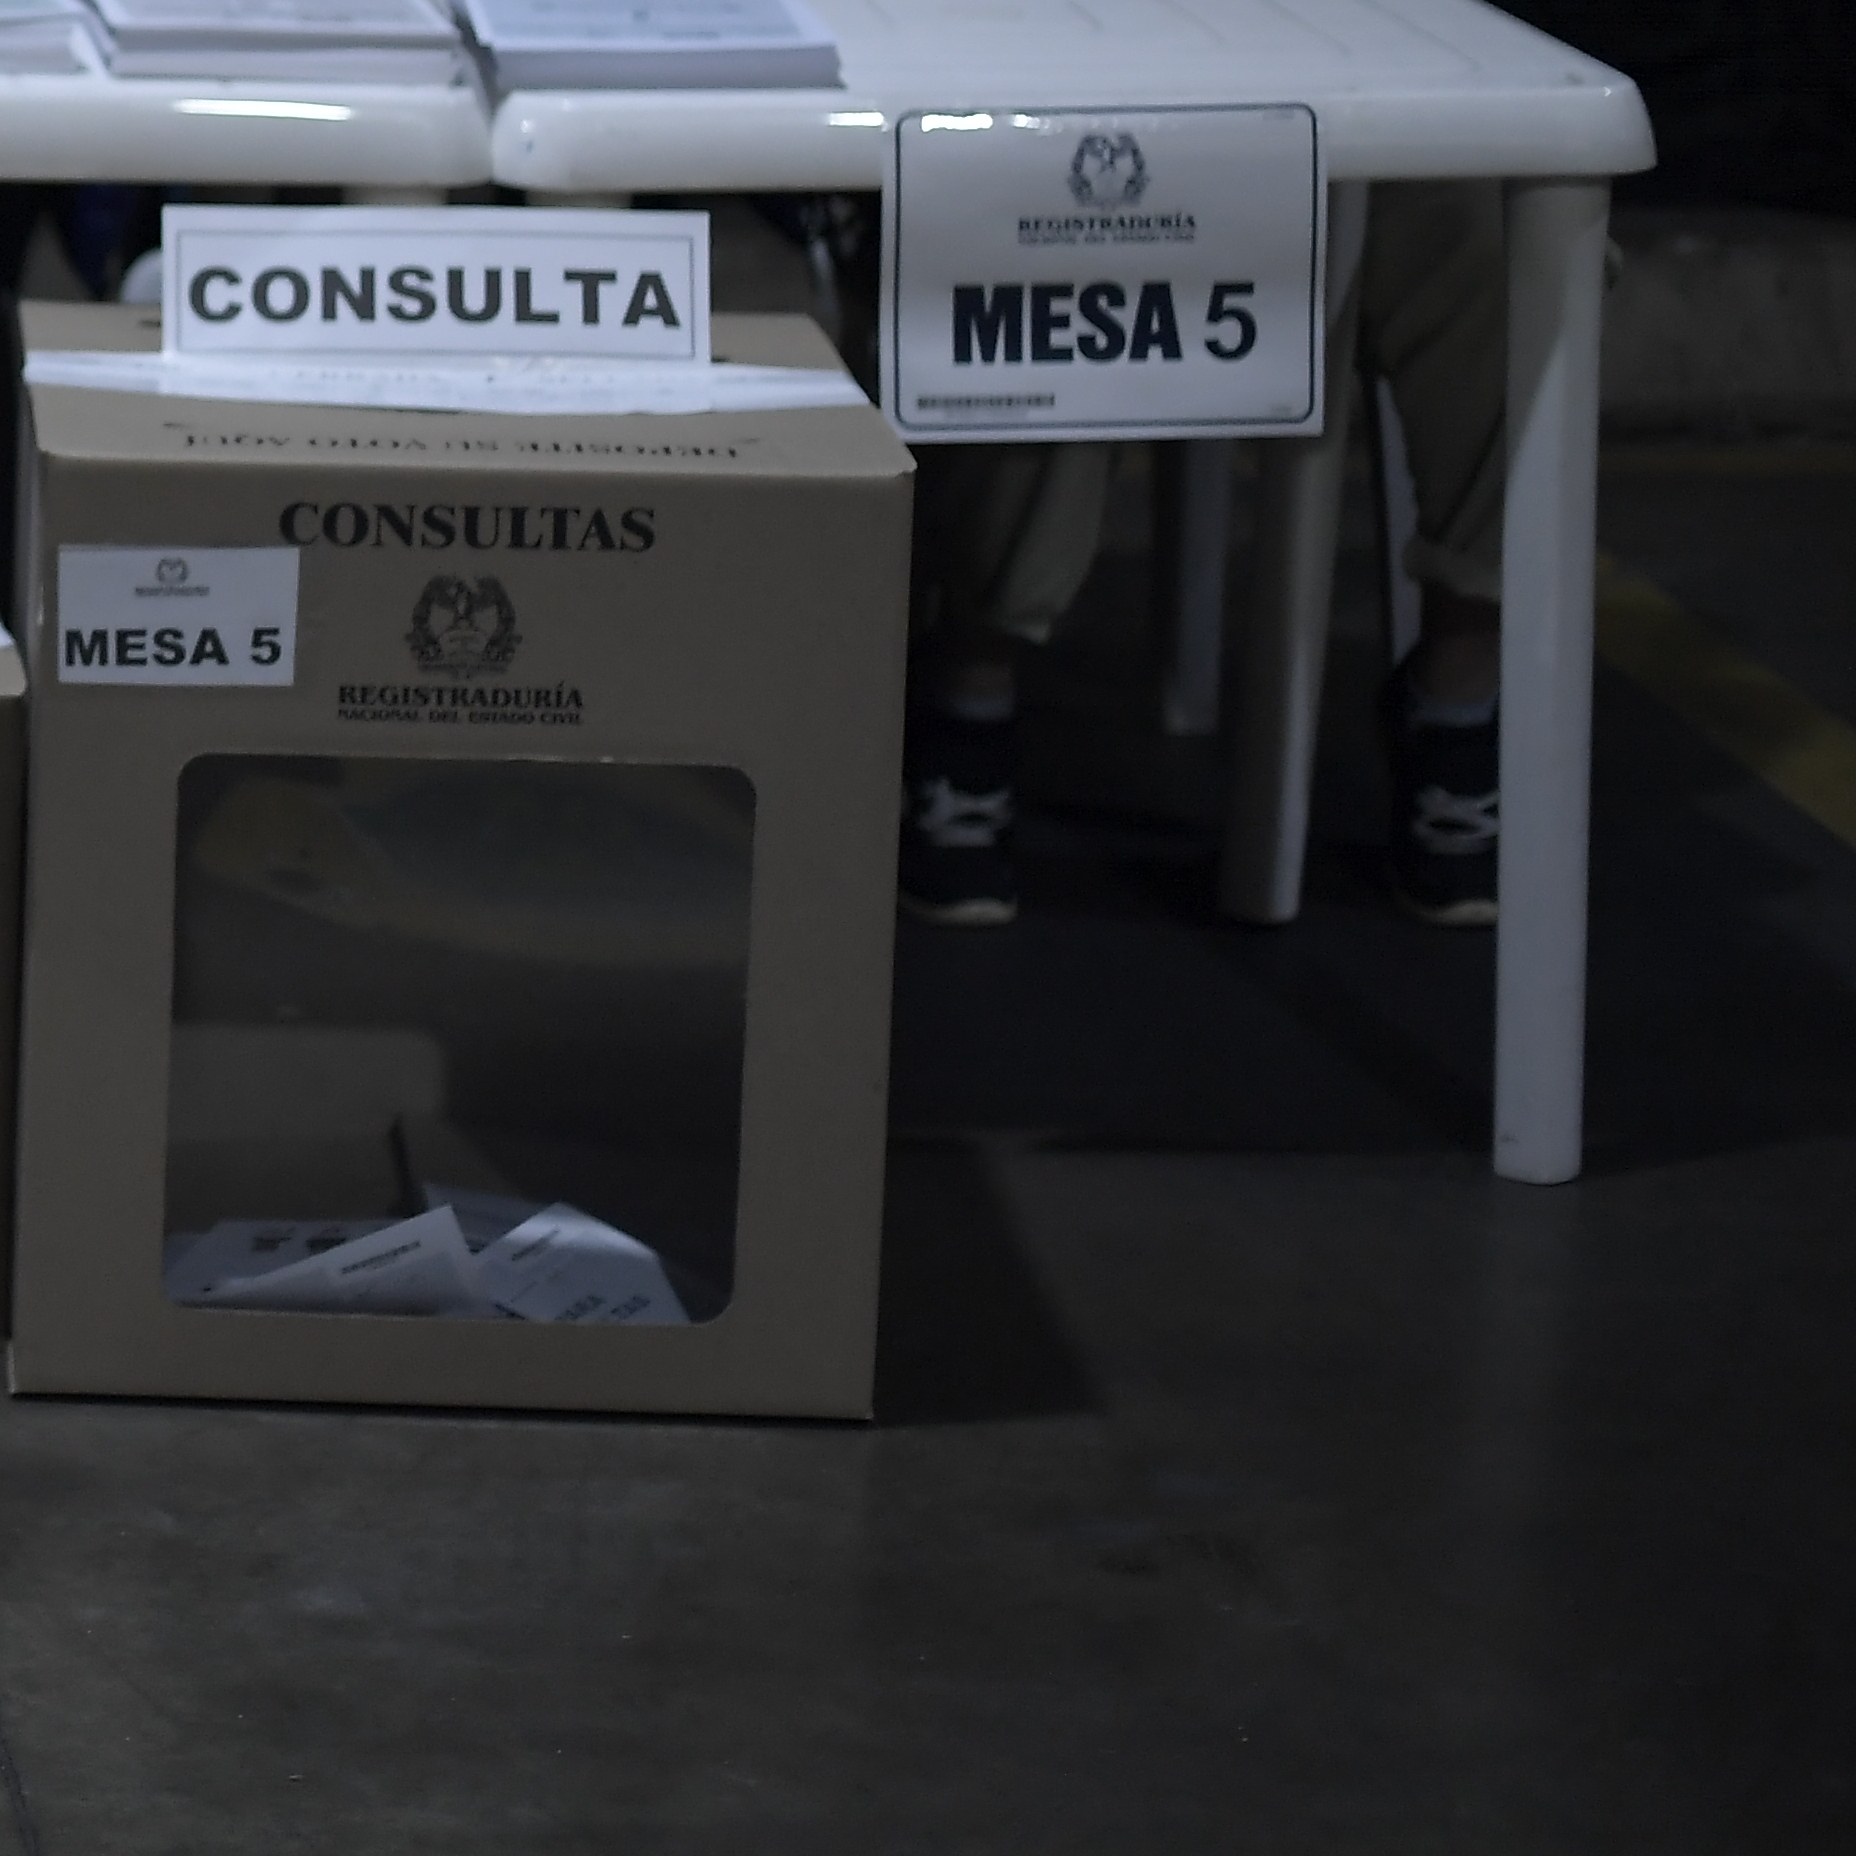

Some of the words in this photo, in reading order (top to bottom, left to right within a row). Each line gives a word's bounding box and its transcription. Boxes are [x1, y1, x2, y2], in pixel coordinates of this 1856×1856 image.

[188, 265, 682, 328] CONSULTA
[952, 281, 1183, 365] MESA
[1204, 280, 1258, 361] 5
[278, 500, 656, 553] CONSULTAS
[65, 626, 229, 667] MESA
[250, 626, 283, 666] 5
[339, 681, 584, 708] REGISTRADURÍA
